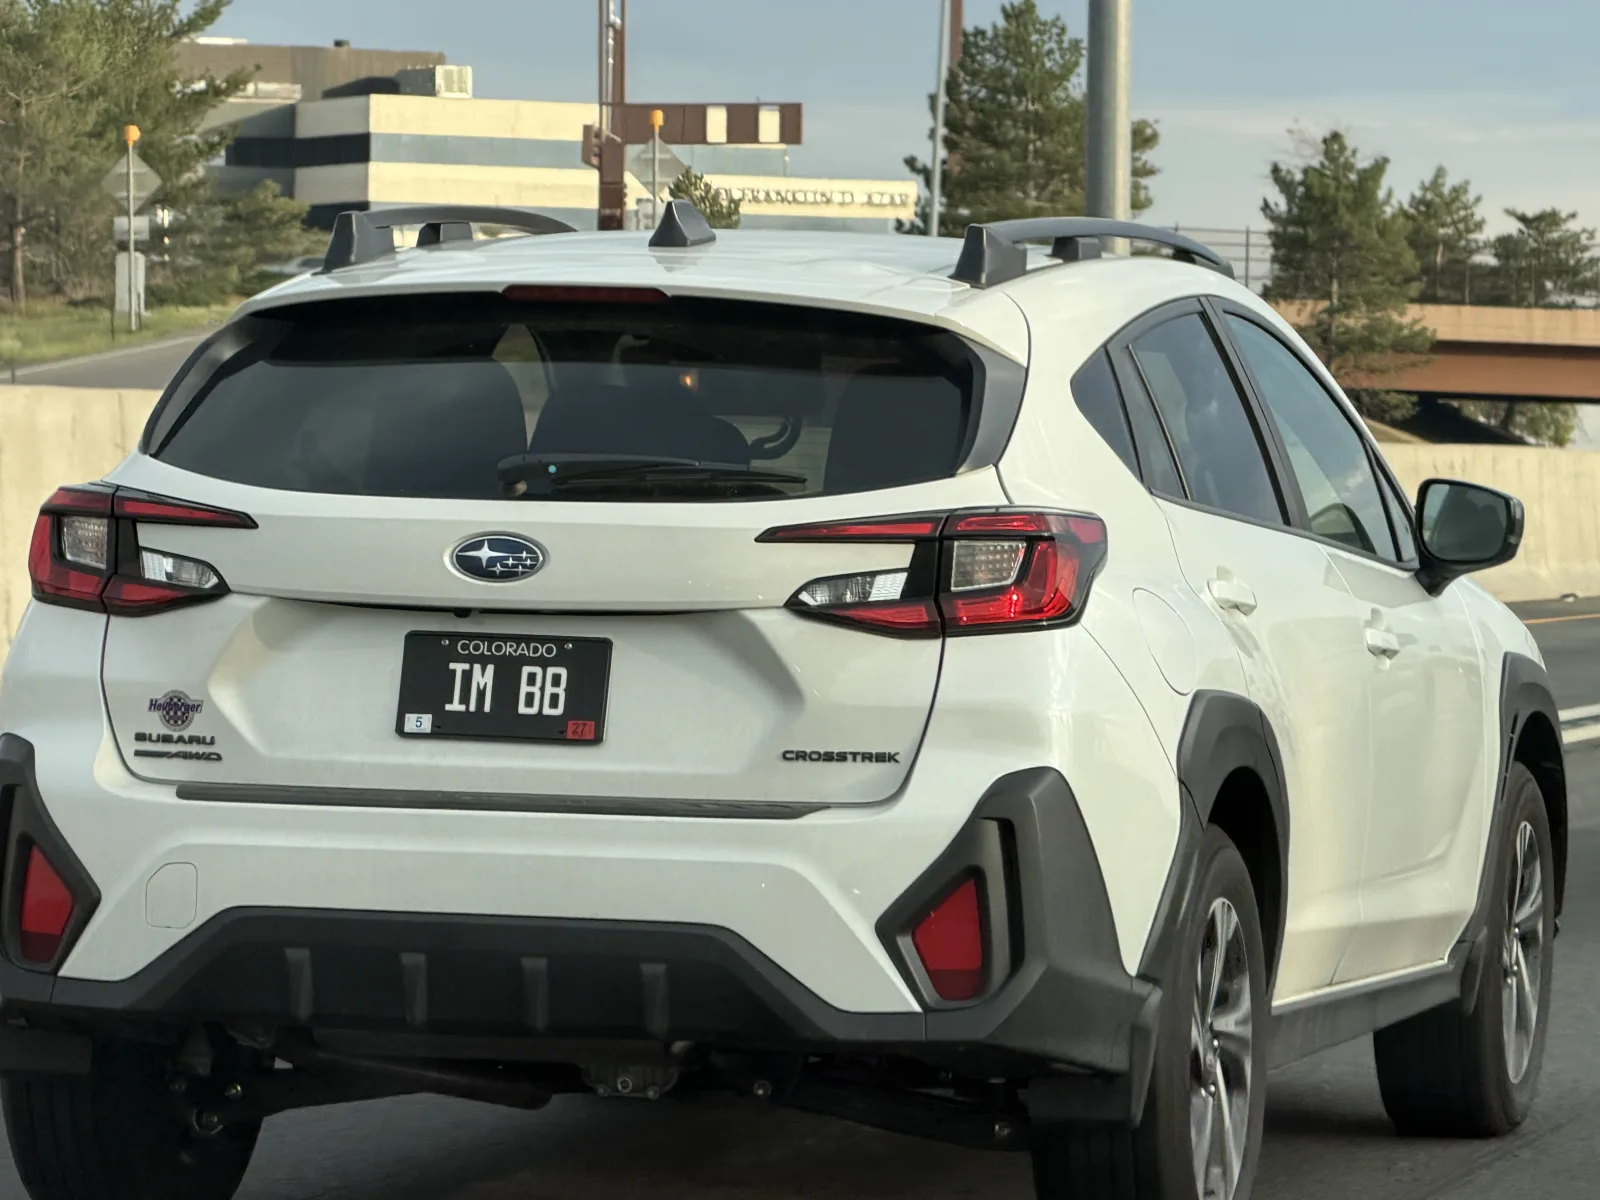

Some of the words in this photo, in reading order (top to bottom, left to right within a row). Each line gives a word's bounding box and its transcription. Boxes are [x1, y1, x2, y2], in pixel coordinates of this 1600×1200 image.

[457, 639, 557, 658] COLORADO
[444, 662, 495, 713] IM
[517, 665, 568, 716] BB
[415, 716, 423, 729] 5
[571, 722, 588, 737] 27
[134, 731, 216, 746] SUBARU
[782, 749, 901, 764] CROSSTREK
